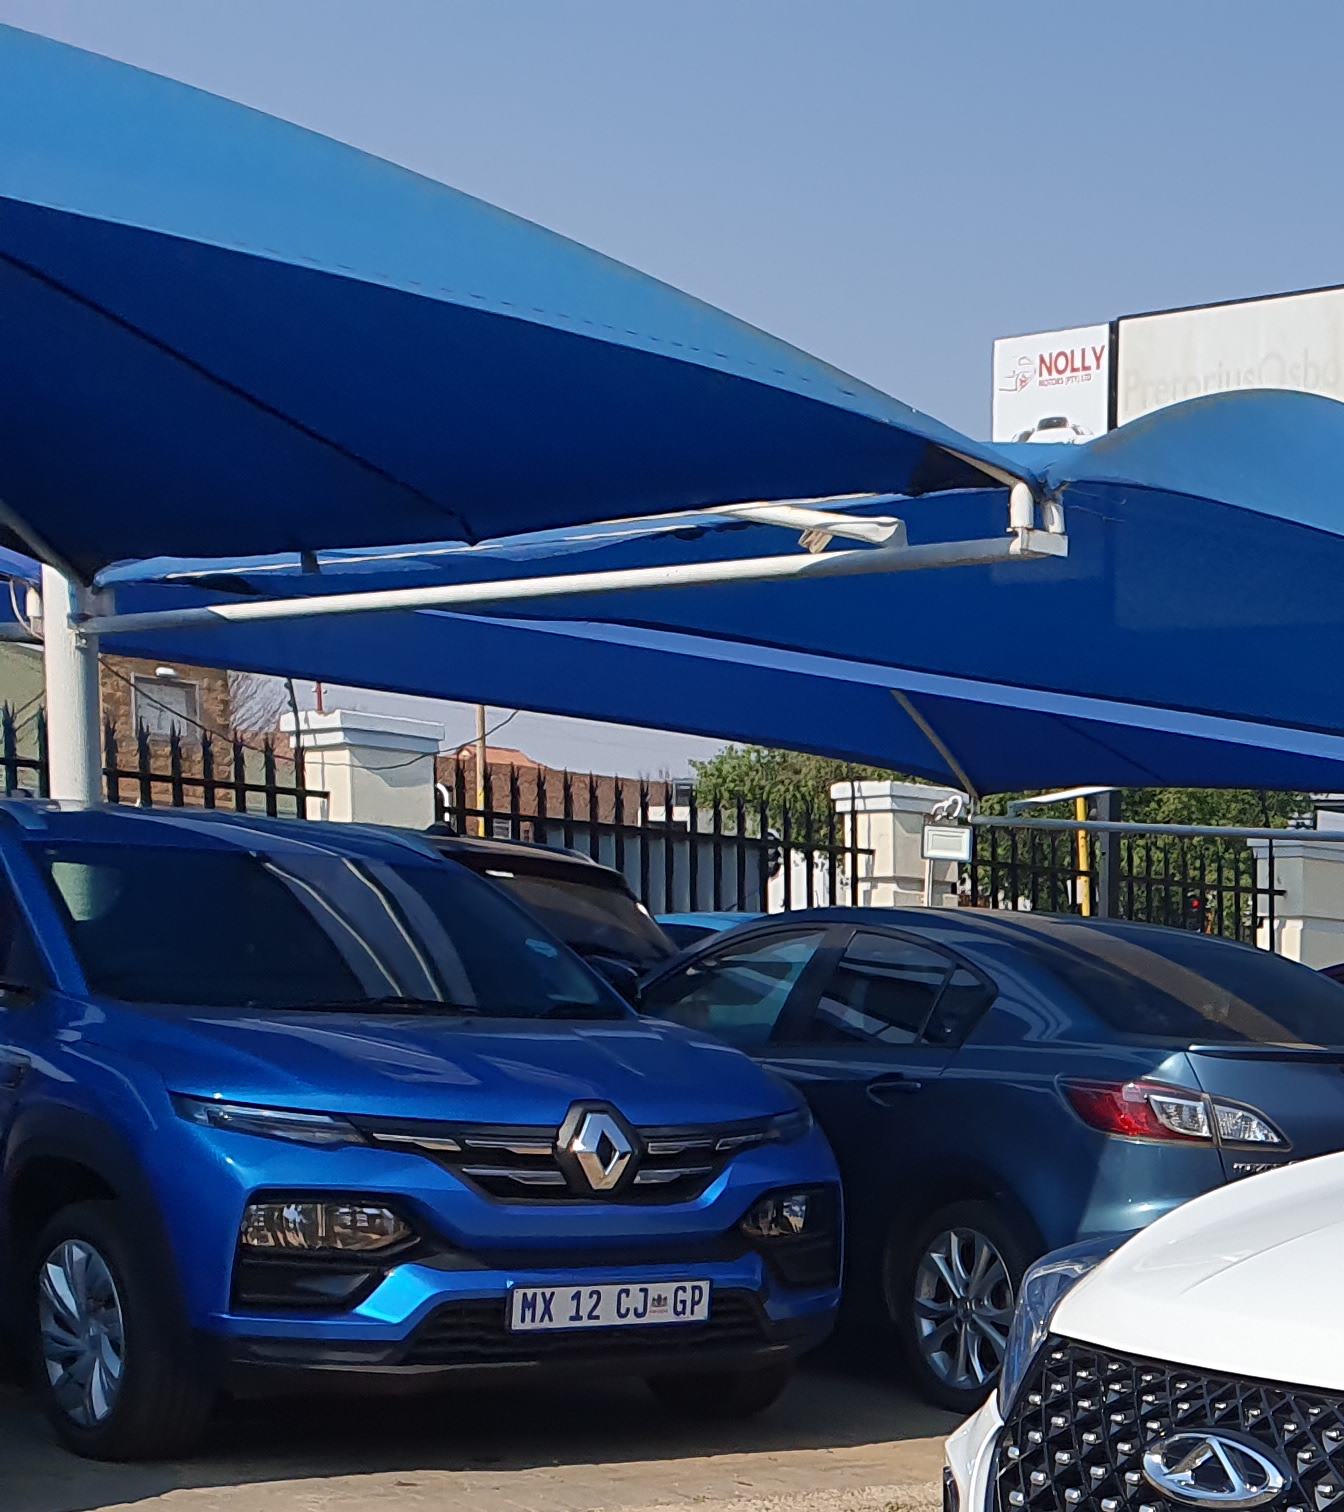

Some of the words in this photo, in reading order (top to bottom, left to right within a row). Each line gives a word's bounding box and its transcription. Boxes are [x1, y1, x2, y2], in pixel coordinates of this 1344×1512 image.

[1038, 344, 1105, 377] NOLLY
[520, 1291, 556, 1324] MX
[568, 1290, 602, 1322] 12
[616, 1287, 649, 1318] CJ
[672, 1284, 704, 1317] GP
